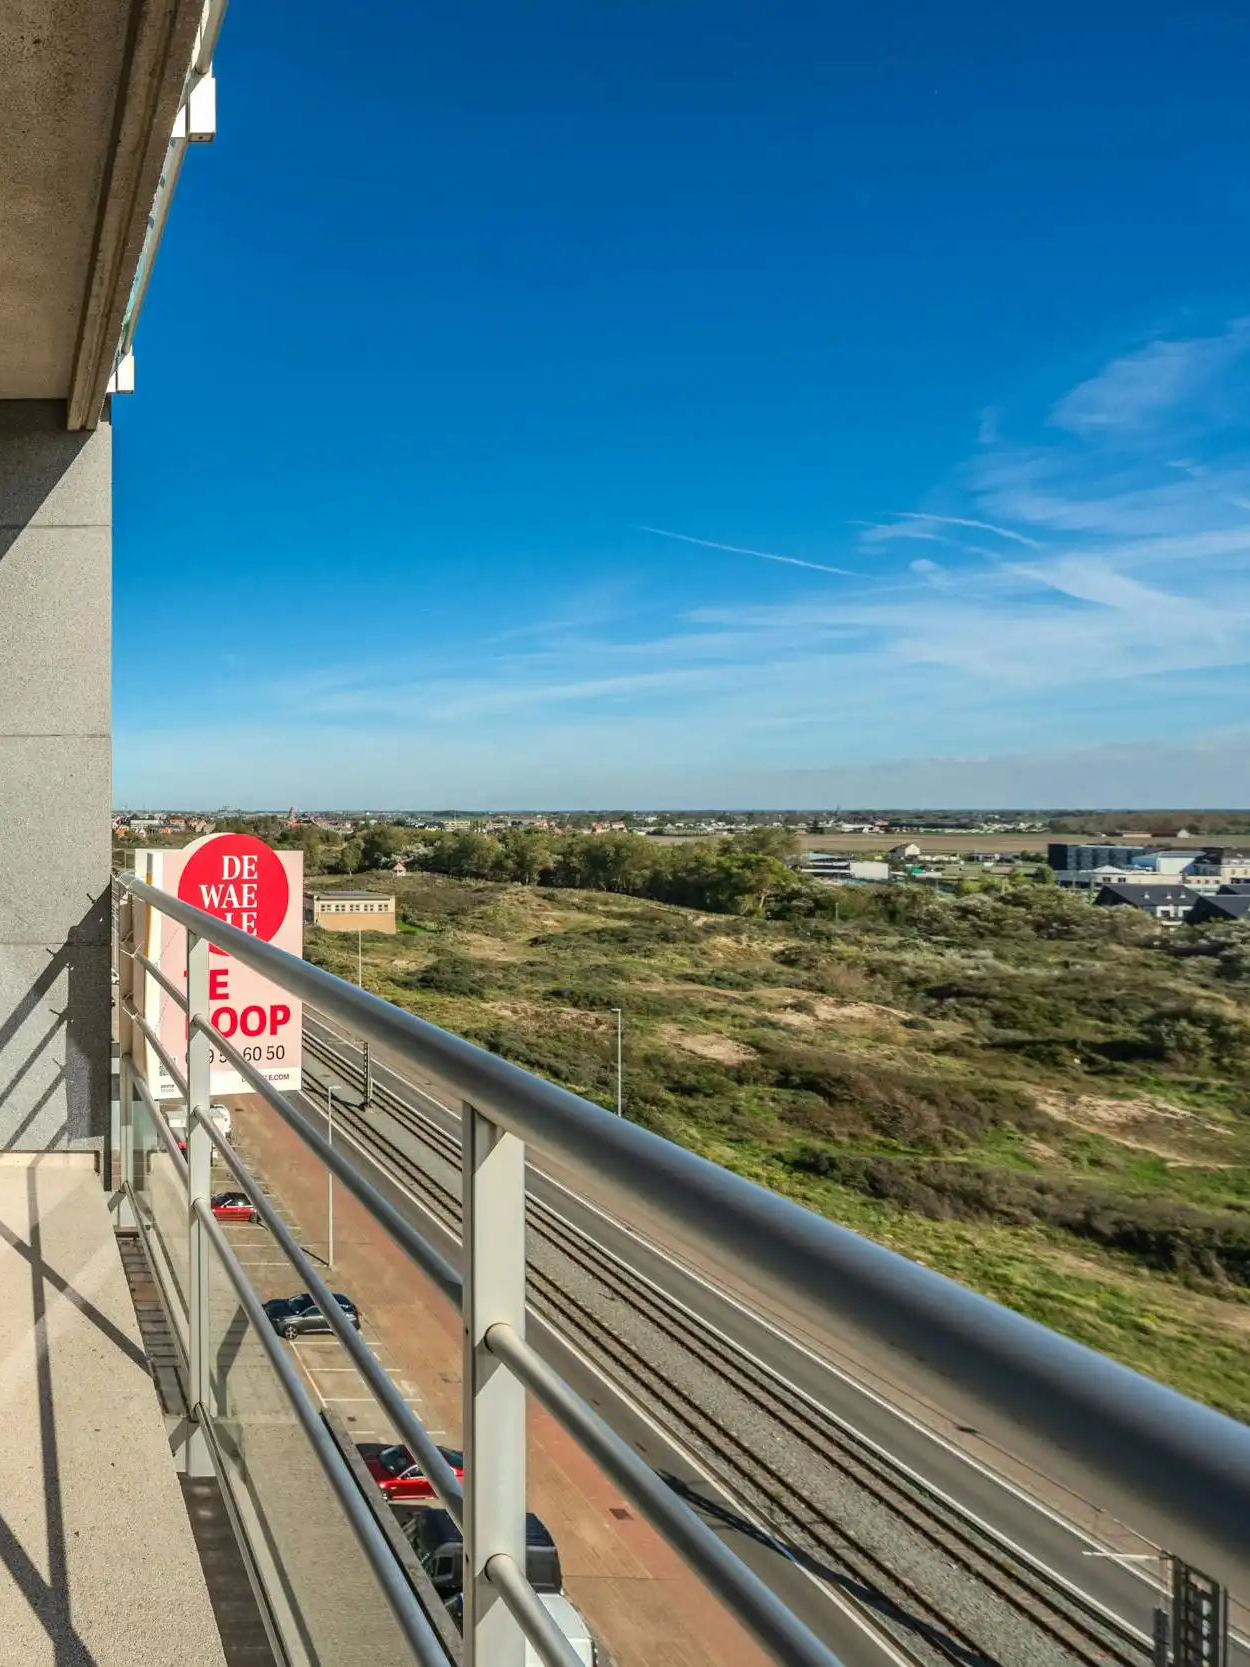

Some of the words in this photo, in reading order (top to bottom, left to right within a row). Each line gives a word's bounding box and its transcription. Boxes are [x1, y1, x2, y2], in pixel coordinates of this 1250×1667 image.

[222, 855, 258, 880] DE
[198, 883, 258, 909] WAE
[185, 1004, 291, 1040] OOP
[243, 1046, 262, 1062] 60
[266, 1045, 285, 1060] 50
